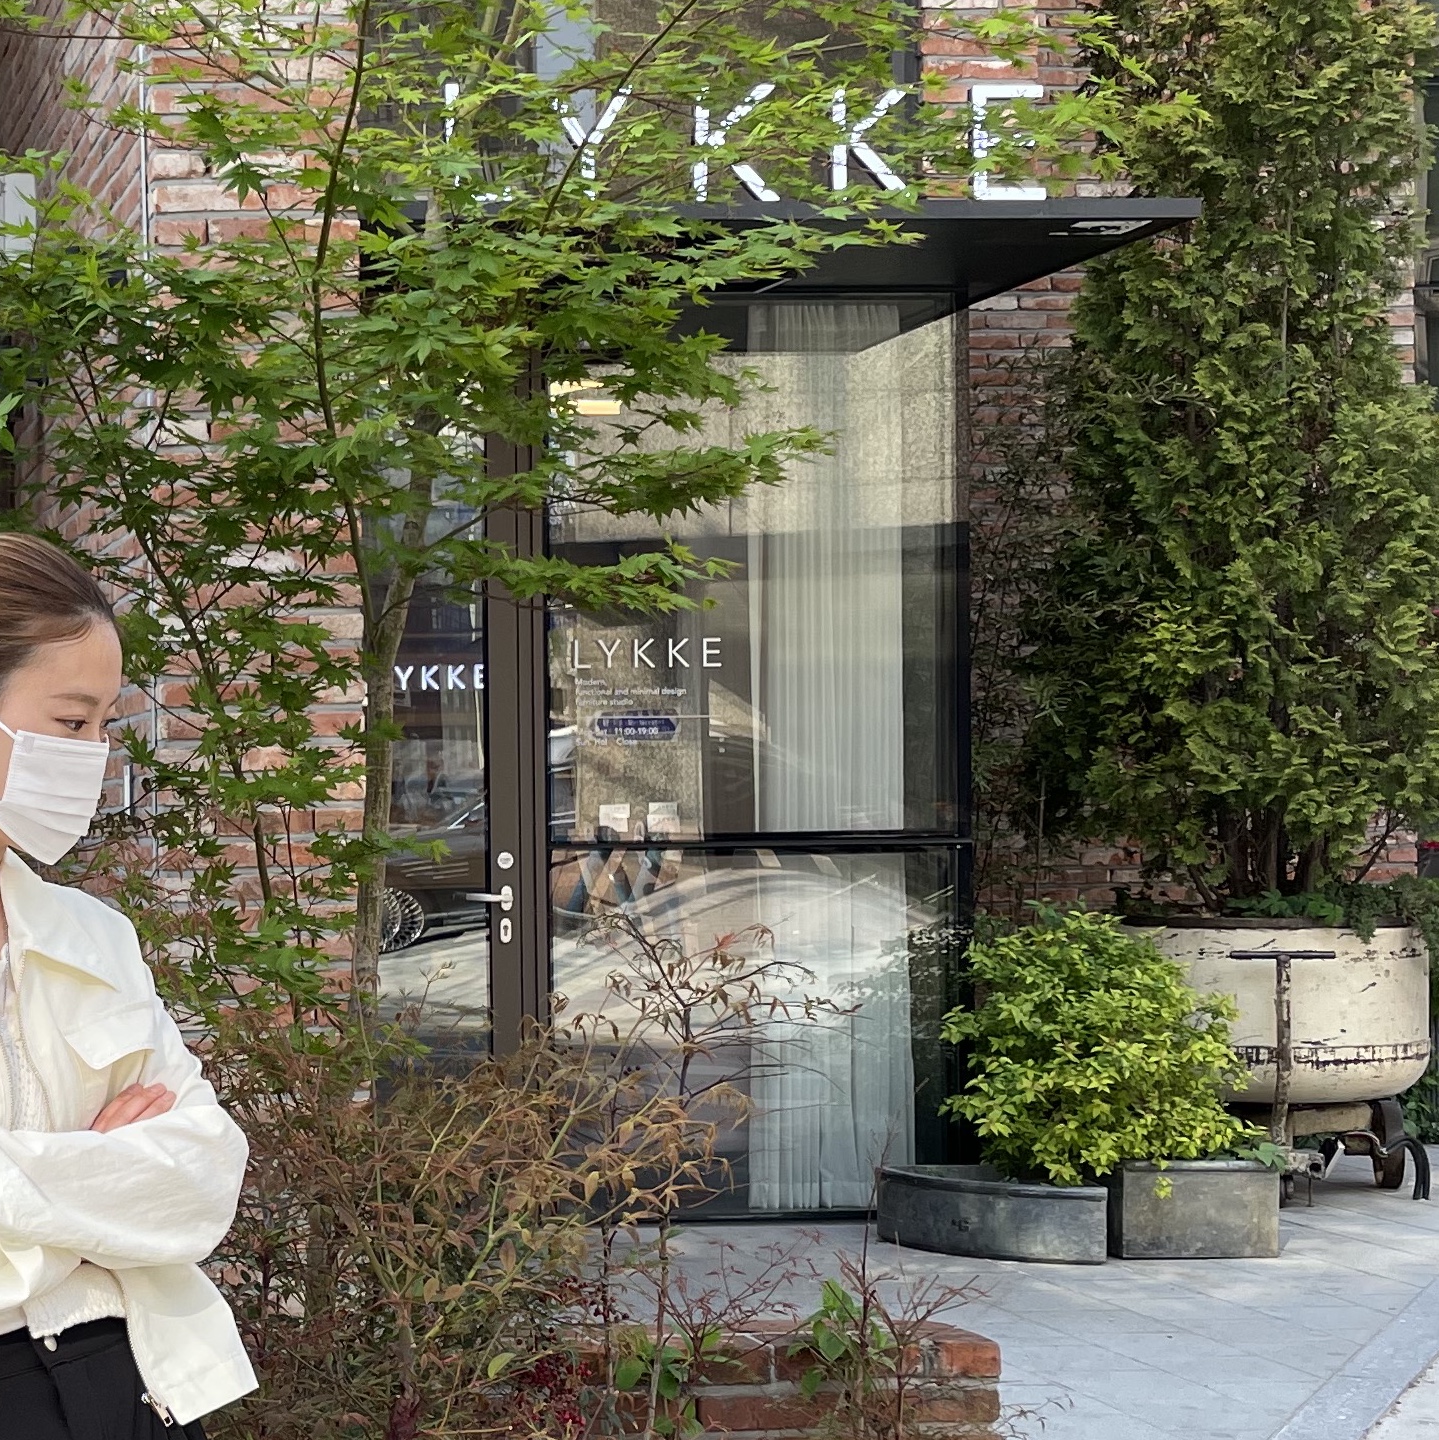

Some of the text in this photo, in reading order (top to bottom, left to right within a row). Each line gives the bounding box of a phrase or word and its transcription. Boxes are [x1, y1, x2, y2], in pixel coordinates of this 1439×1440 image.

[574, 637, 723, 669] LYKKE
[393, 663, 485, 691] YKKE
[661, 686, 687, 698] design
